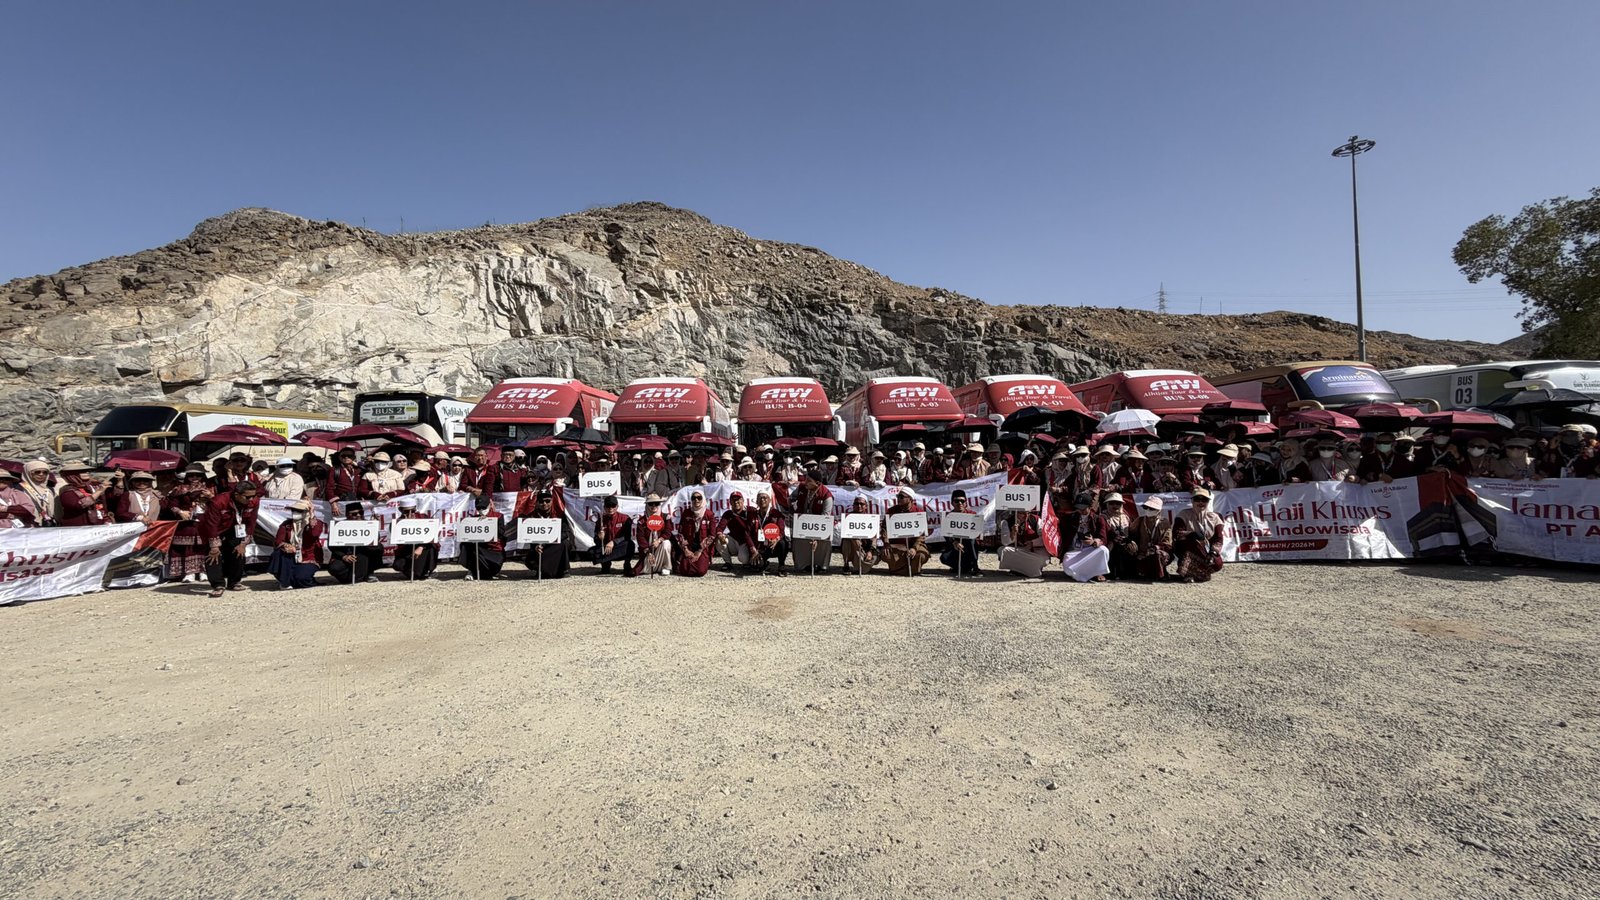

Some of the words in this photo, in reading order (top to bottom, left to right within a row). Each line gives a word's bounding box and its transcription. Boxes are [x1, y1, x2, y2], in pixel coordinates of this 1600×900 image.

[1458, 376, 1473, 386] BUS
[1455, 388, 1473, 404] 03
[587, 480, 605, 488] BUS
[1005, 493, 1025, 502] BUS
[1026, 494, 1031, 502] 1
[1258, 503, 1305, 521] Haji
[1311, 500, 1392, 519] Khusus
[464, 525, 483, 534] BUS
[483, 525, 490, 533] 8
[801, 522, 819, 531] BUS
[820, 523, 826, 531] 5
[849, 522, 866, 530] BUS
[867, 522, 873, 530] 4
[950, 520, 968, 529] BUS
[970, 522, 976, 530] 2
[1276, 522, 1371, 537] Indowisata
[338, 529, 358, 537] BUS
[360, 529, 370, 537] 10
[401, 527, 422, 535] BUS
[423, 527, 430, 535] 9
[1545, 523, 1576, 537] PT
[0, 550, 100, 569] husus
